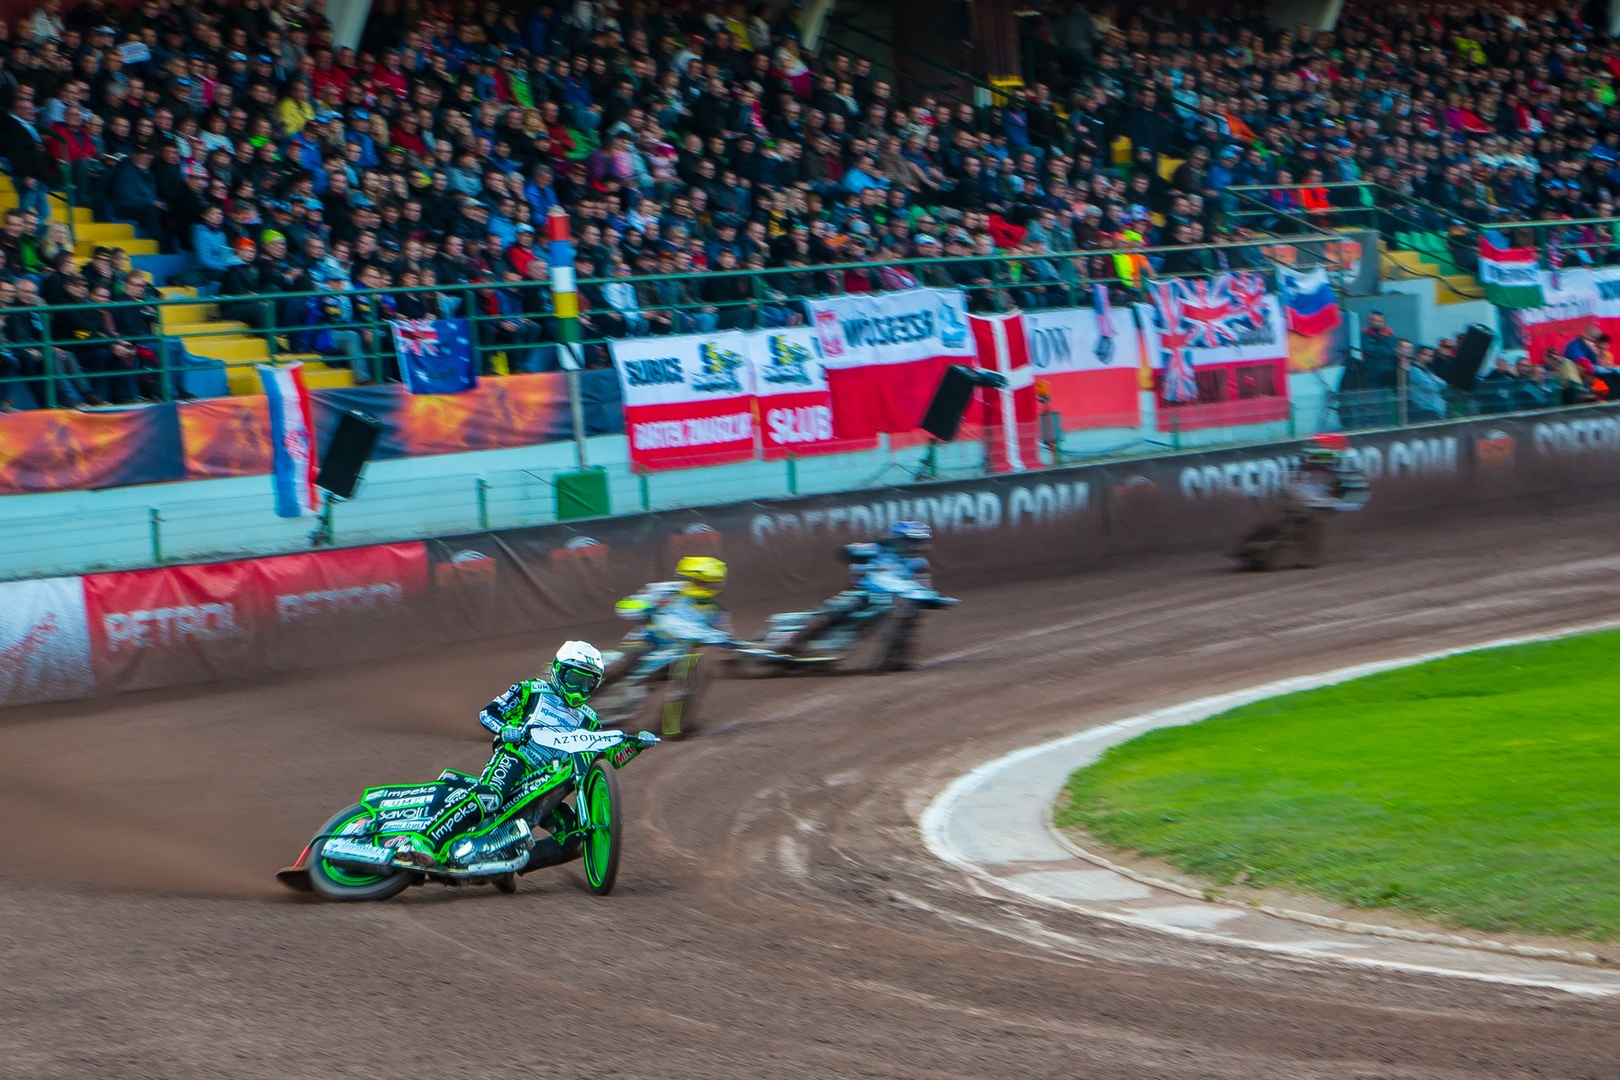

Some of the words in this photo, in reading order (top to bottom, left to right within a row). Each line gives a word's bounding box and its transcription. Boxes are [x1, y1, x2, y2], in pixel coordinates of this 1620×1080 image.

[103, 601, 240, 652] PETROL
[553, 734, 612, 746] AZTORIN
[384, 787, 436, 798] Impeks
[501, 790, 530, 812] ZIELONA
[431, 801, 477, 841] Impeks
